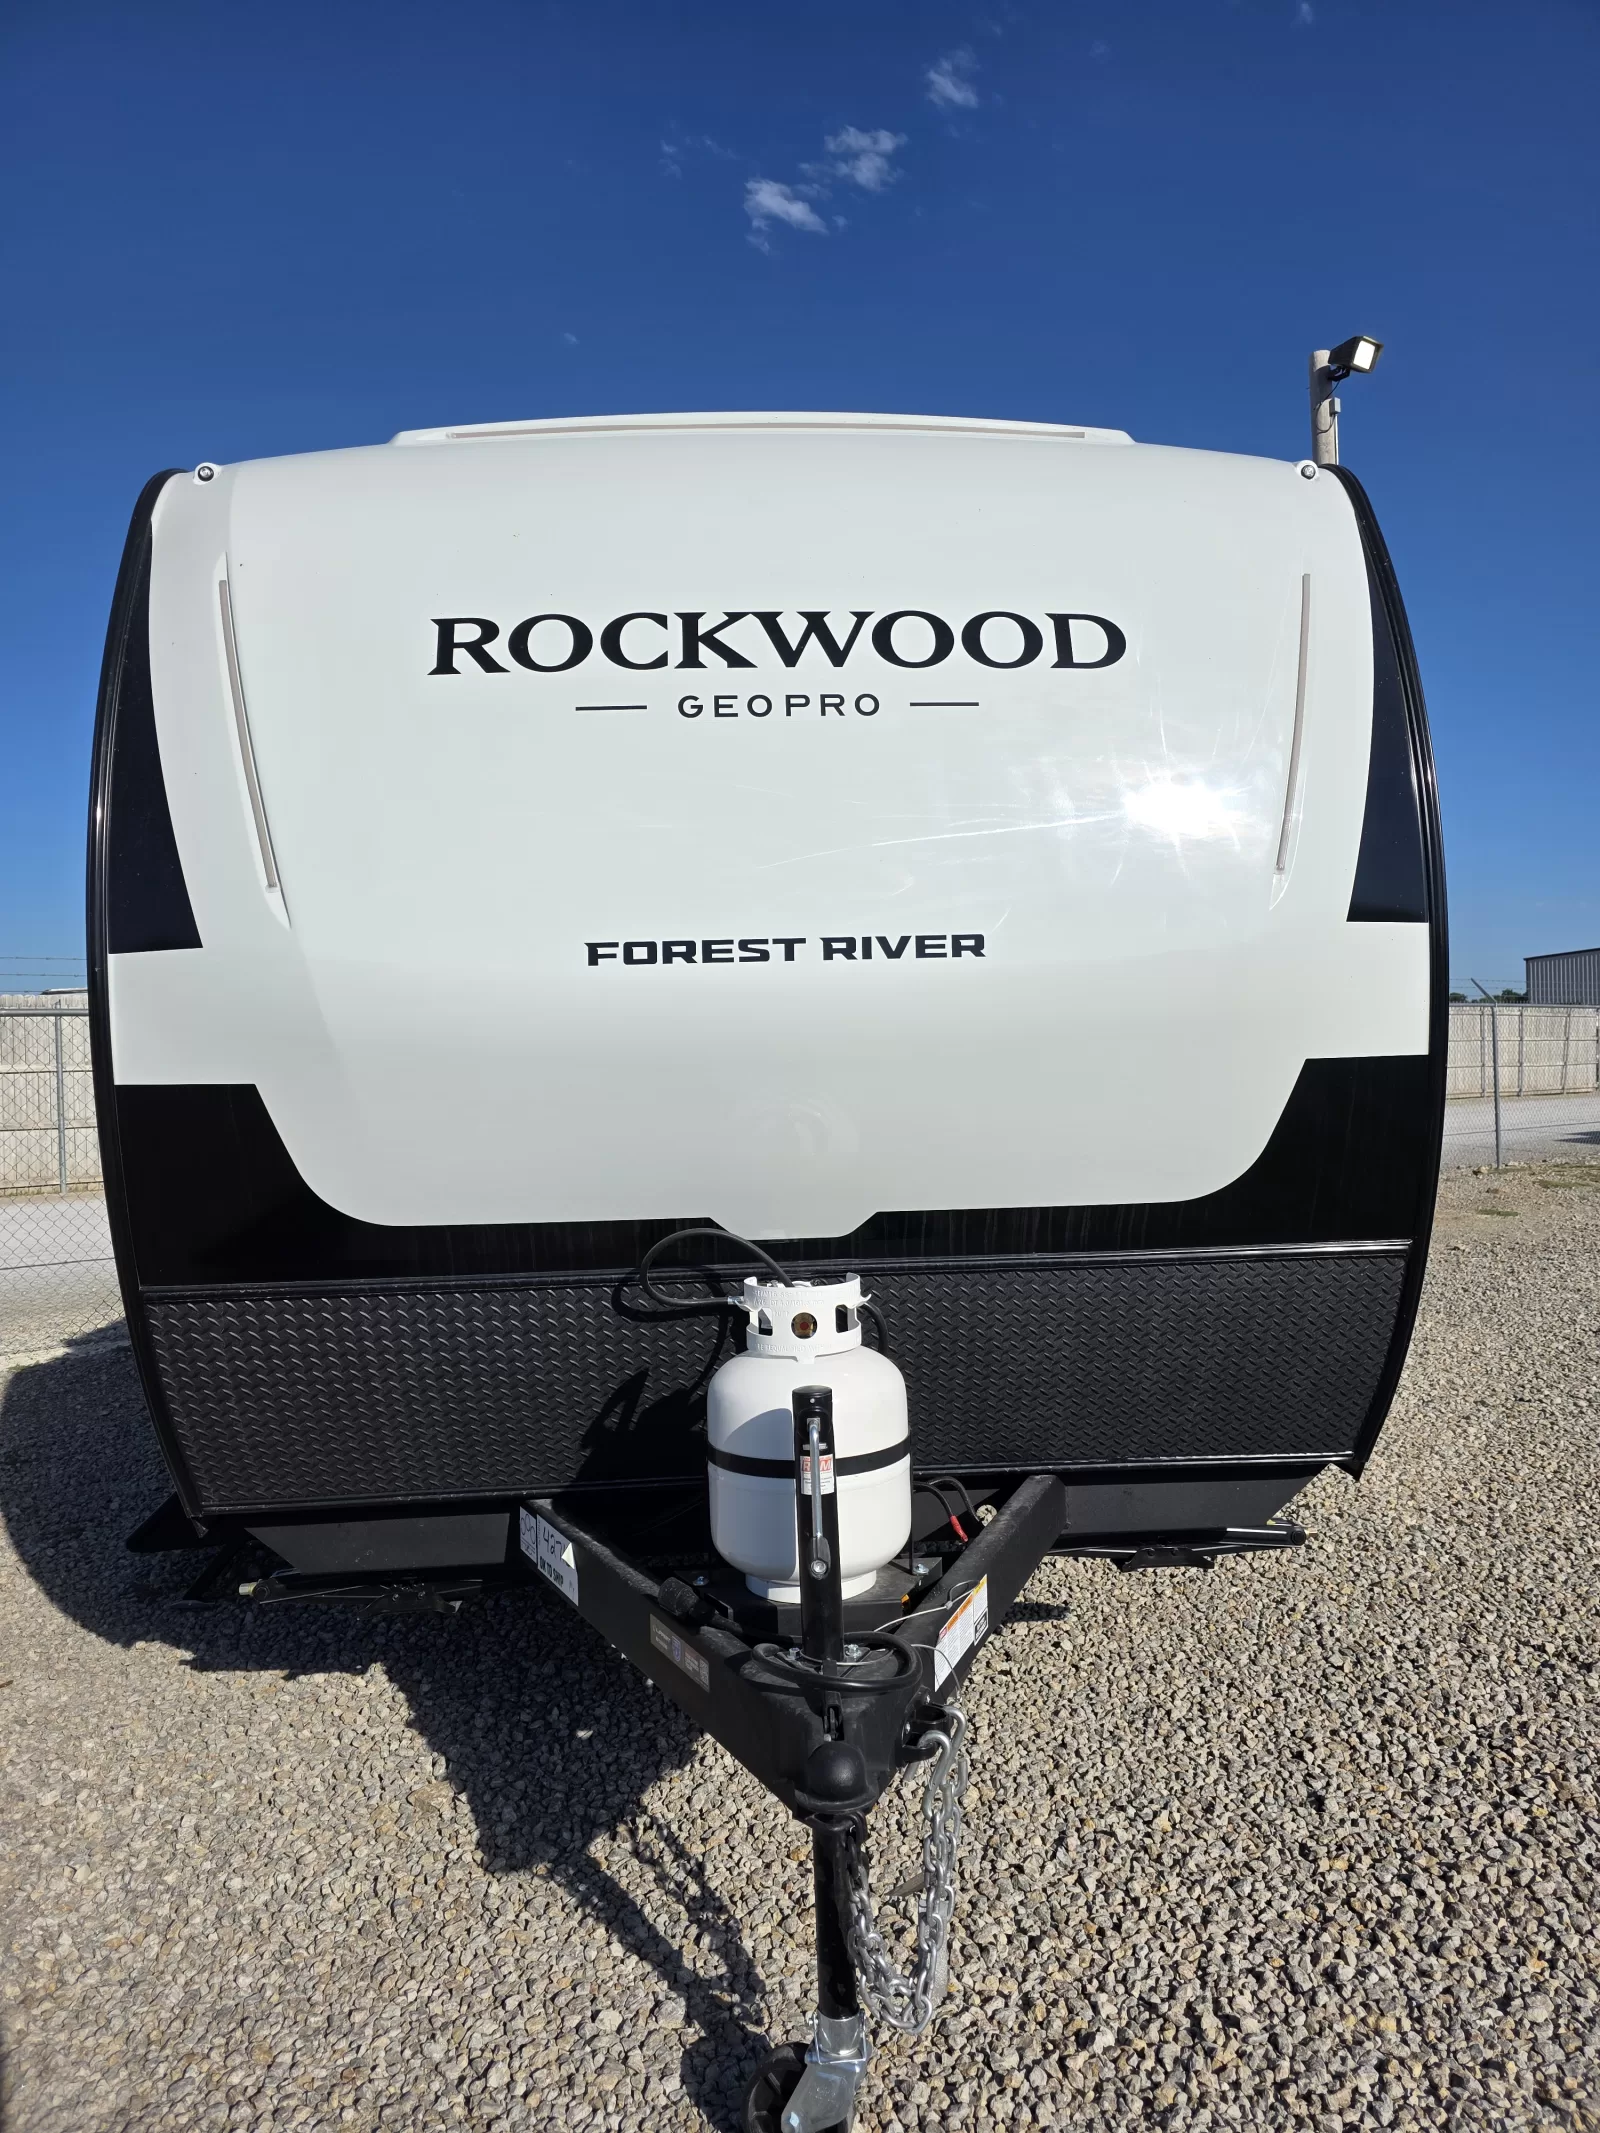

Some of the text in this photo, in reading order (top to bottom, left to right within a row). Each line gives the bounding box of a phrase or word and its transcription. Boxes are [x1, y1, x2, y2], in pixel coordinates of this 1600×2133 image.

[428, 610, 1127, 675] ROCKWOOD
[678, 693, 880, 718] GEOPRO
[585, 934, 986, 967] FOREST RIVER
[802, 1459, 832, 1472] RM
